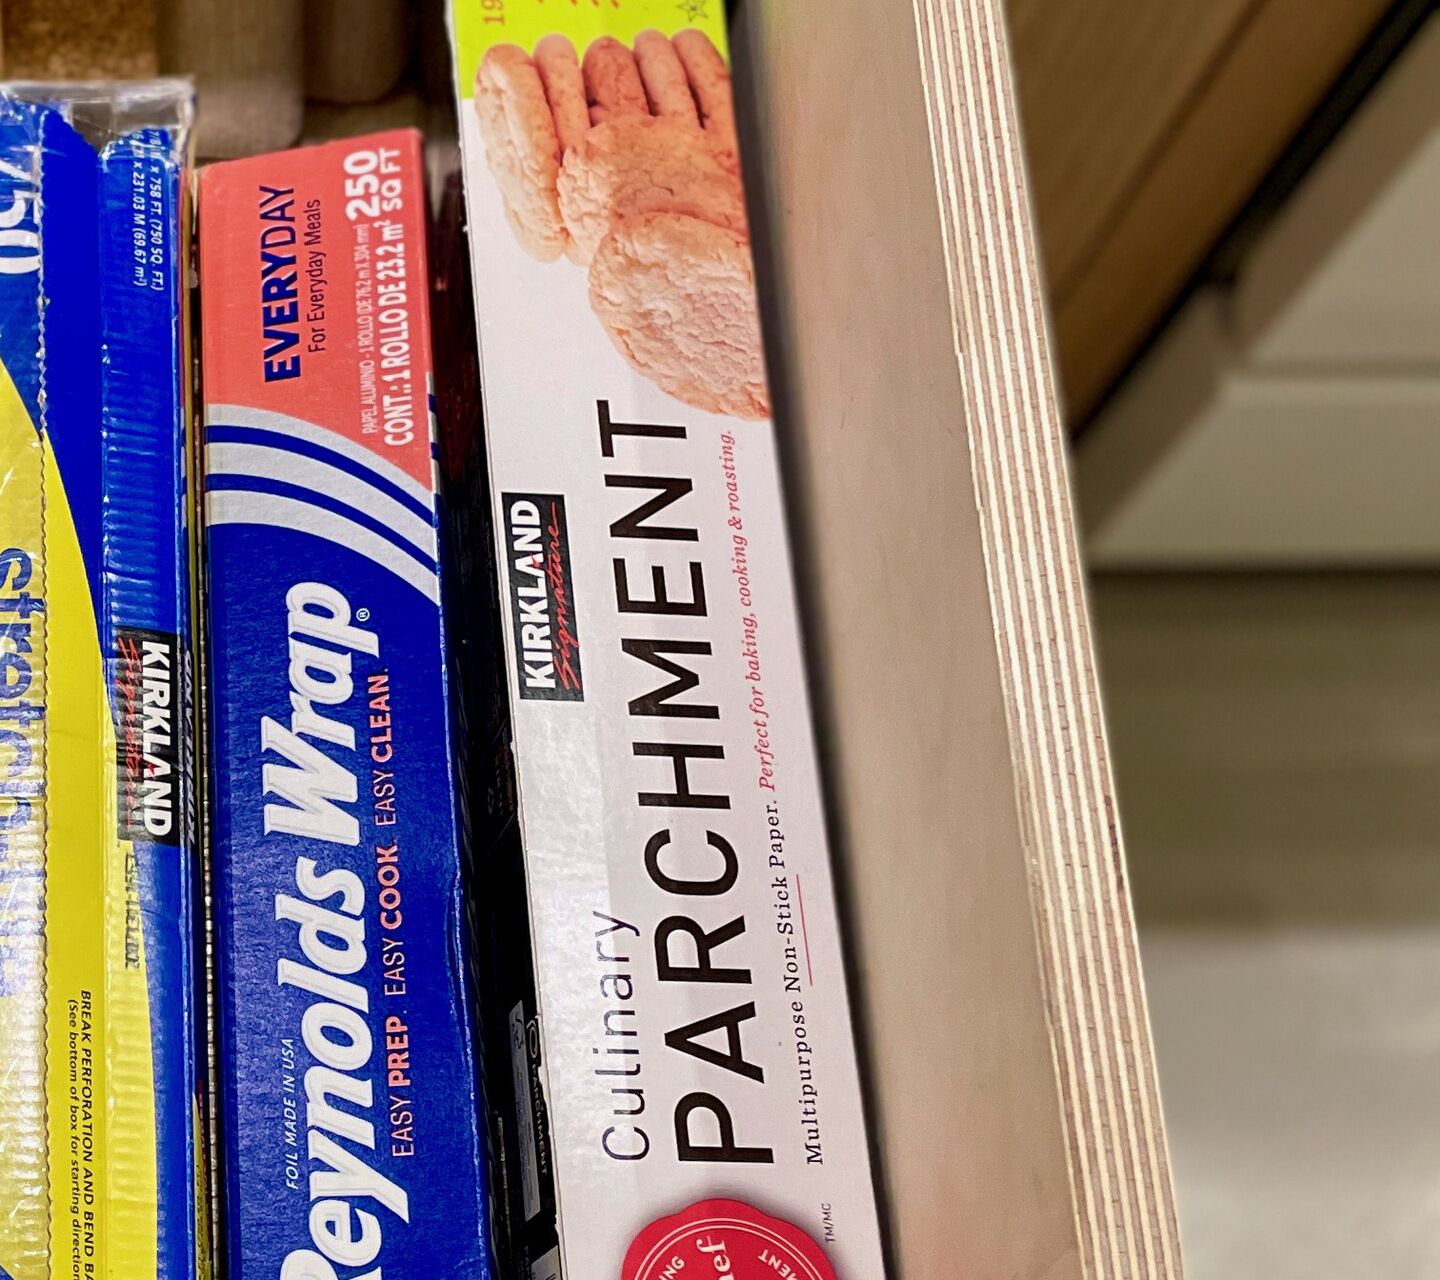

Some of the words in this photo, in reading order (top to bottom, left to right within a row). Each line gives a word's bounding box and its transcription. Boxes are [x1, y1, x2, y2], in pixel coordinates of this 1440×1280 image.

[379, 147, 401, 174] FT
[132, 171, 146, 212] 231.03
[149, 177, 162, 199] 758
[344, 150, 380, 221] 250
[379, 178, 403, 211] SQ
[133, 215, 146, 226] M
[150, 216, 164, 244] (750
[302, 199, 321, 248] Meals
[373, 219, 404, 242] m²
[133, 227, 147, 263] (69.67
[375, 242, 407, 280] 23.2
[259, 185, 301, 382] EVERYDAY
[306, 251, 327, 321] Everyday
[355, 279, 372, 299] 76.2
[376, 280, 407, 307] DE
[308, 327, 326, 353] For
[357, 315, 374, 346] ROLLO
[378, 308, 410, 368] ROLLO
[359, 360, 377, 404] ALUMINIO
[381, 369, 411, 382] 1
[361, 405, 378, 435] PAPEL
[720, 429, 739, 512] roasting.
[727, 516, 742, 531] &
[732, 535, 752, 608] cooking
[509, 499, 556, 690] KIRKLAND
[545, 501, 581, 691] Signature
[742, 613, 761, 682] baking,
[749, 686, 768, 719] for
[142, 640, 172, 837] KIRKLAND
[754, 715, 776, 792] Perfect
[373, 769, 397, 826] EASY
[596, 399, 775, 1164] PARCHMENT
[766, 800, 786, 869] Paper.
[770, 875, 802, 992] Non-Stick
[382, 937, 407, 996] EASY
[67, 998, 78, 1028] (See
[81, 989, 92, 1043] BREAK
[68, 1031, 78, 1083] bottom
[280, 1038, 295, 1070] USA
[593, 910, 650, 1161] Culinary
[69, 1086, 79, 1102] of
[282, 1073, 296, 1091] IN
[792, 1001, 824, 1165] Multipurpose
[69, 1105, 78, 1131] box
[81, 1047, 94, 1163] PERFORATION
[282, 1094, 298, 1147] MADE
[389, 1094, 415, 1158] EASY
[70, 1134, 80, 1153] for
[69, 1158, 80, 1214] starting
[83, 1168, 94, 1206] AND
[285, 1149, 300, 1190] FOIL
[83, 1210, 95, 1257] BEND
[821, 1202, 835, 1243] TM/MC
